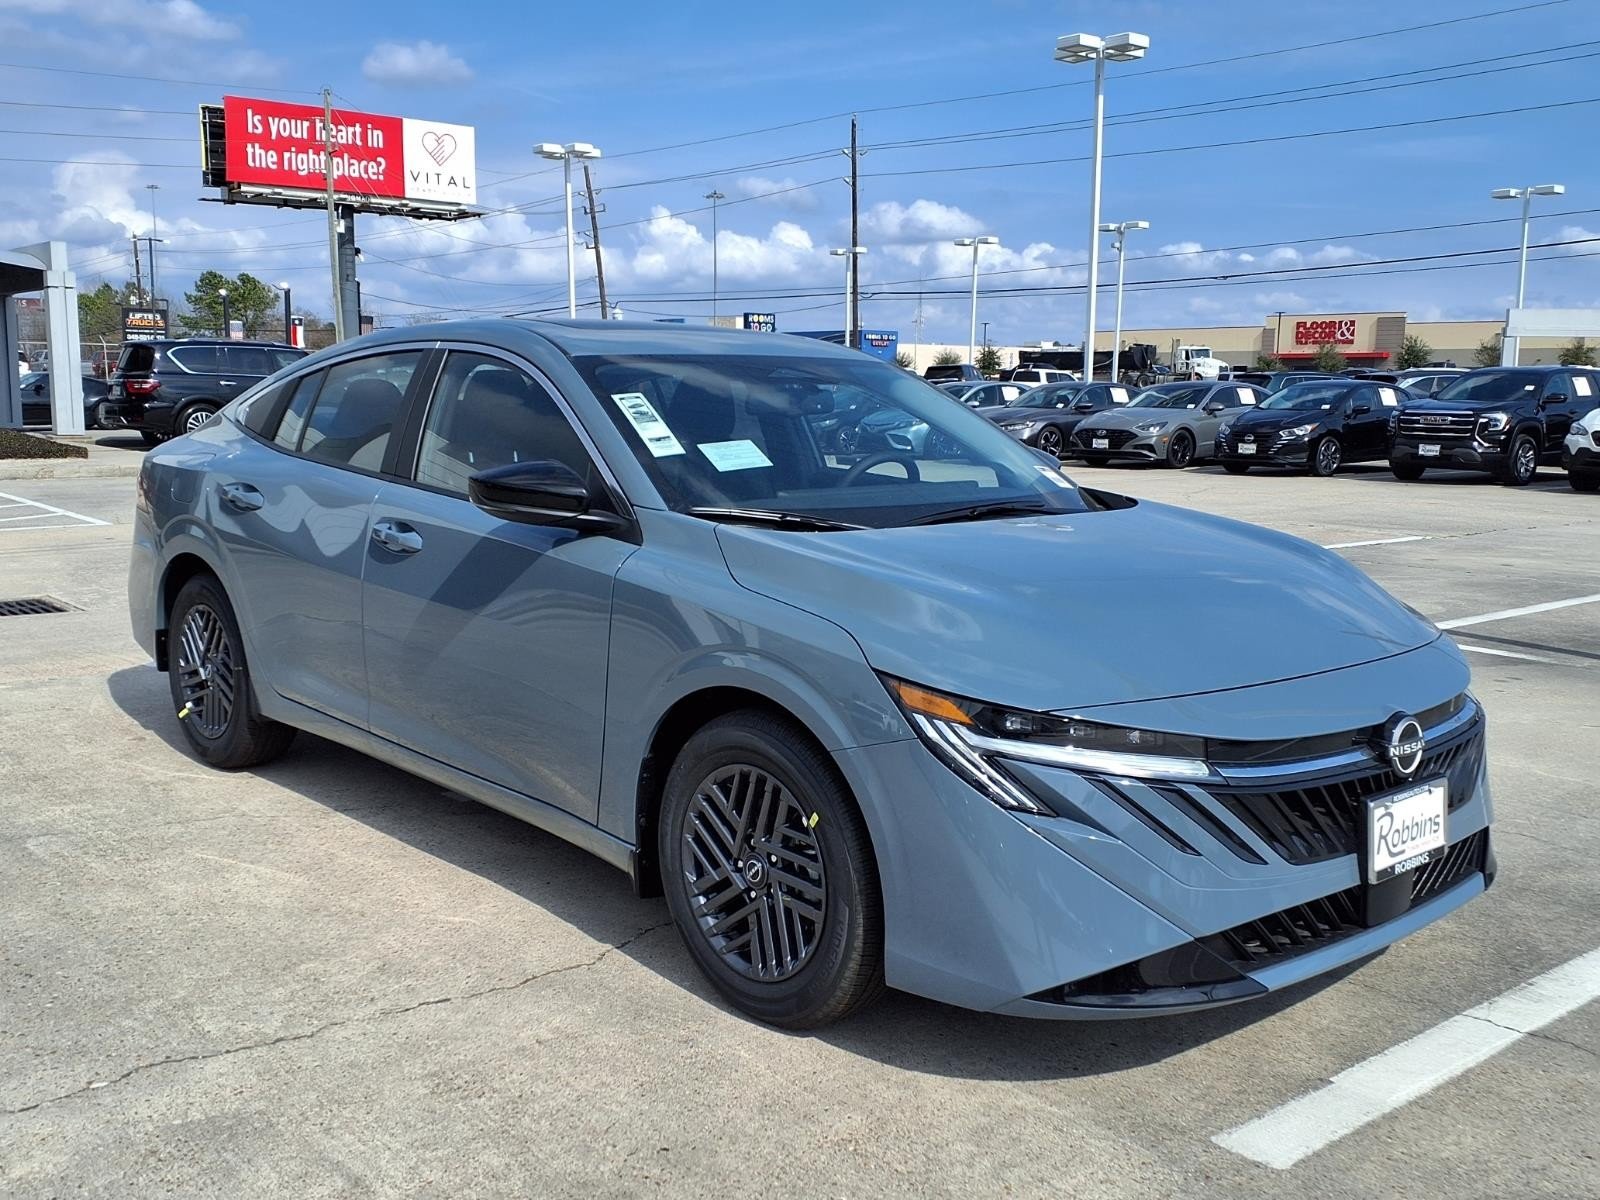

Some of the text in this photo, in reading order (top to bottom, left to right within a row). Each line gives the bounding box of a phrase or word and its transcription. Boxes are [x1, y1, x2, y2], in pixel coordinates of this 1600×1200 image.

[246, 108, 383, 148] Is your heart in
[246, 143, 386, 180] the right place?
[410, 169, 471, 189] VITAL
[129, 312, 161, 320] LIFTED
[749, 314, 774, 323] ROOMS
[751, 323, 772, 332] TO GO
[1296, 320, 1355, 340] FLOOR &
[1296, 330, 1337, 340] DECOR
[1377, 811, 1440, 858] Robbins
[1394, 852, 1430, 875] ROBBINS
